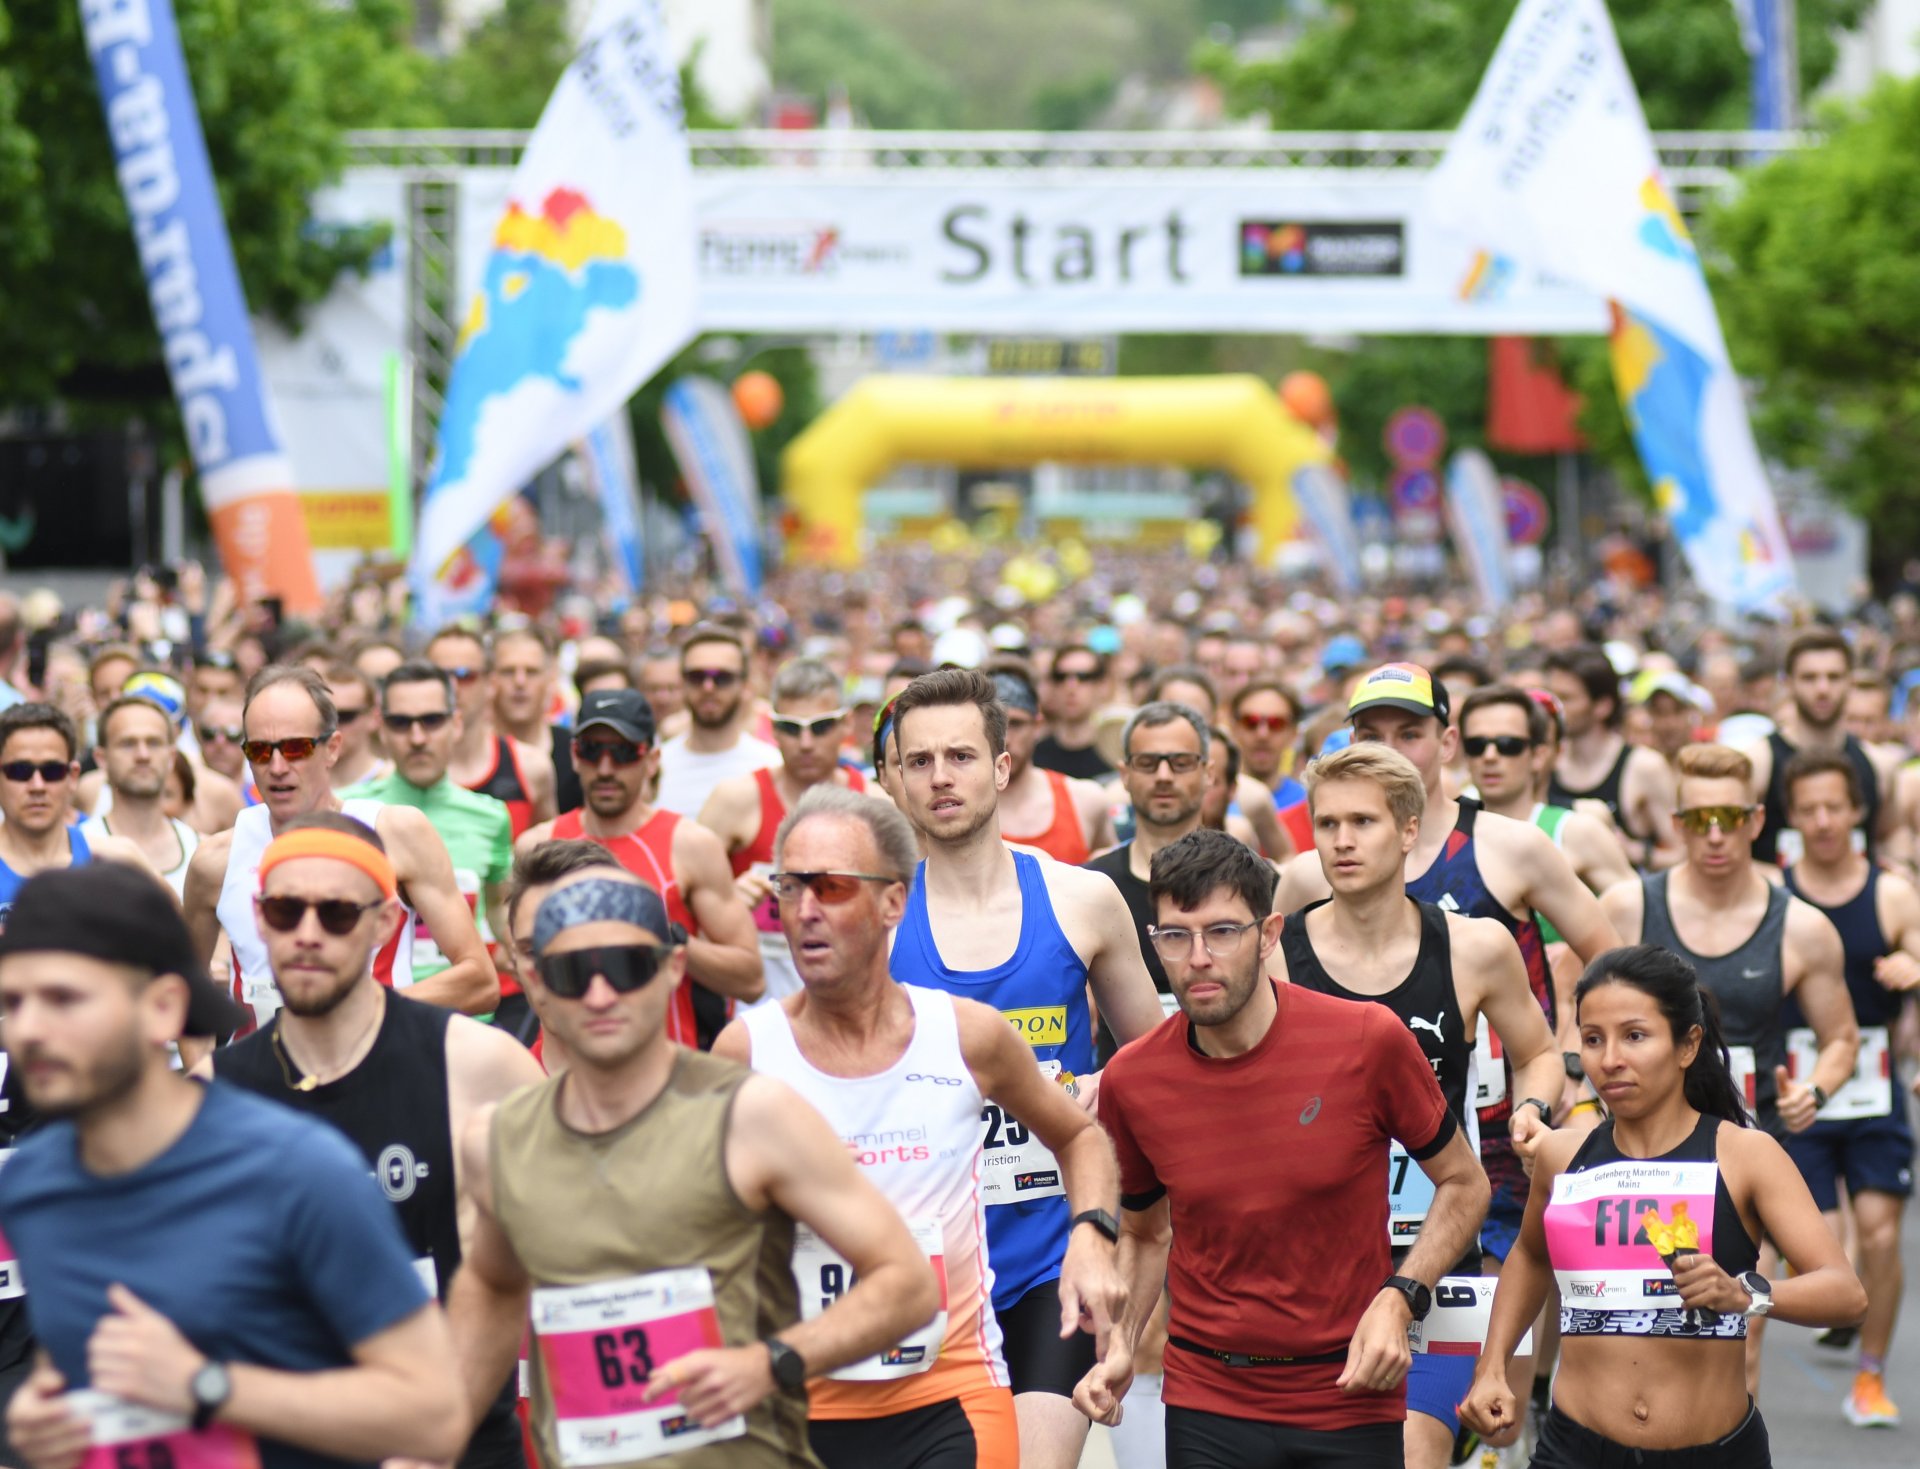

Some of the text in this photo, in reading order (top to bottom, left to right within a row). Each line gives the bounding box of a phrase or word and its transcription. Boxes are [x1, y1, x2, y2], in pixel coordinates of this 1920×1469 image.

[941, 205, 1194, 285] Start
[840, 1123, 926, 1145] immel
[848, 1143, 929, 1166] orts
[1594, 1167, 1671, 1181] Gutenberg Marathon
[1617, 1179, 1641, 1188] Mainz
[1595, 1199, 1659, 1246] F12
[594, 1328, 654, 1389] 63
